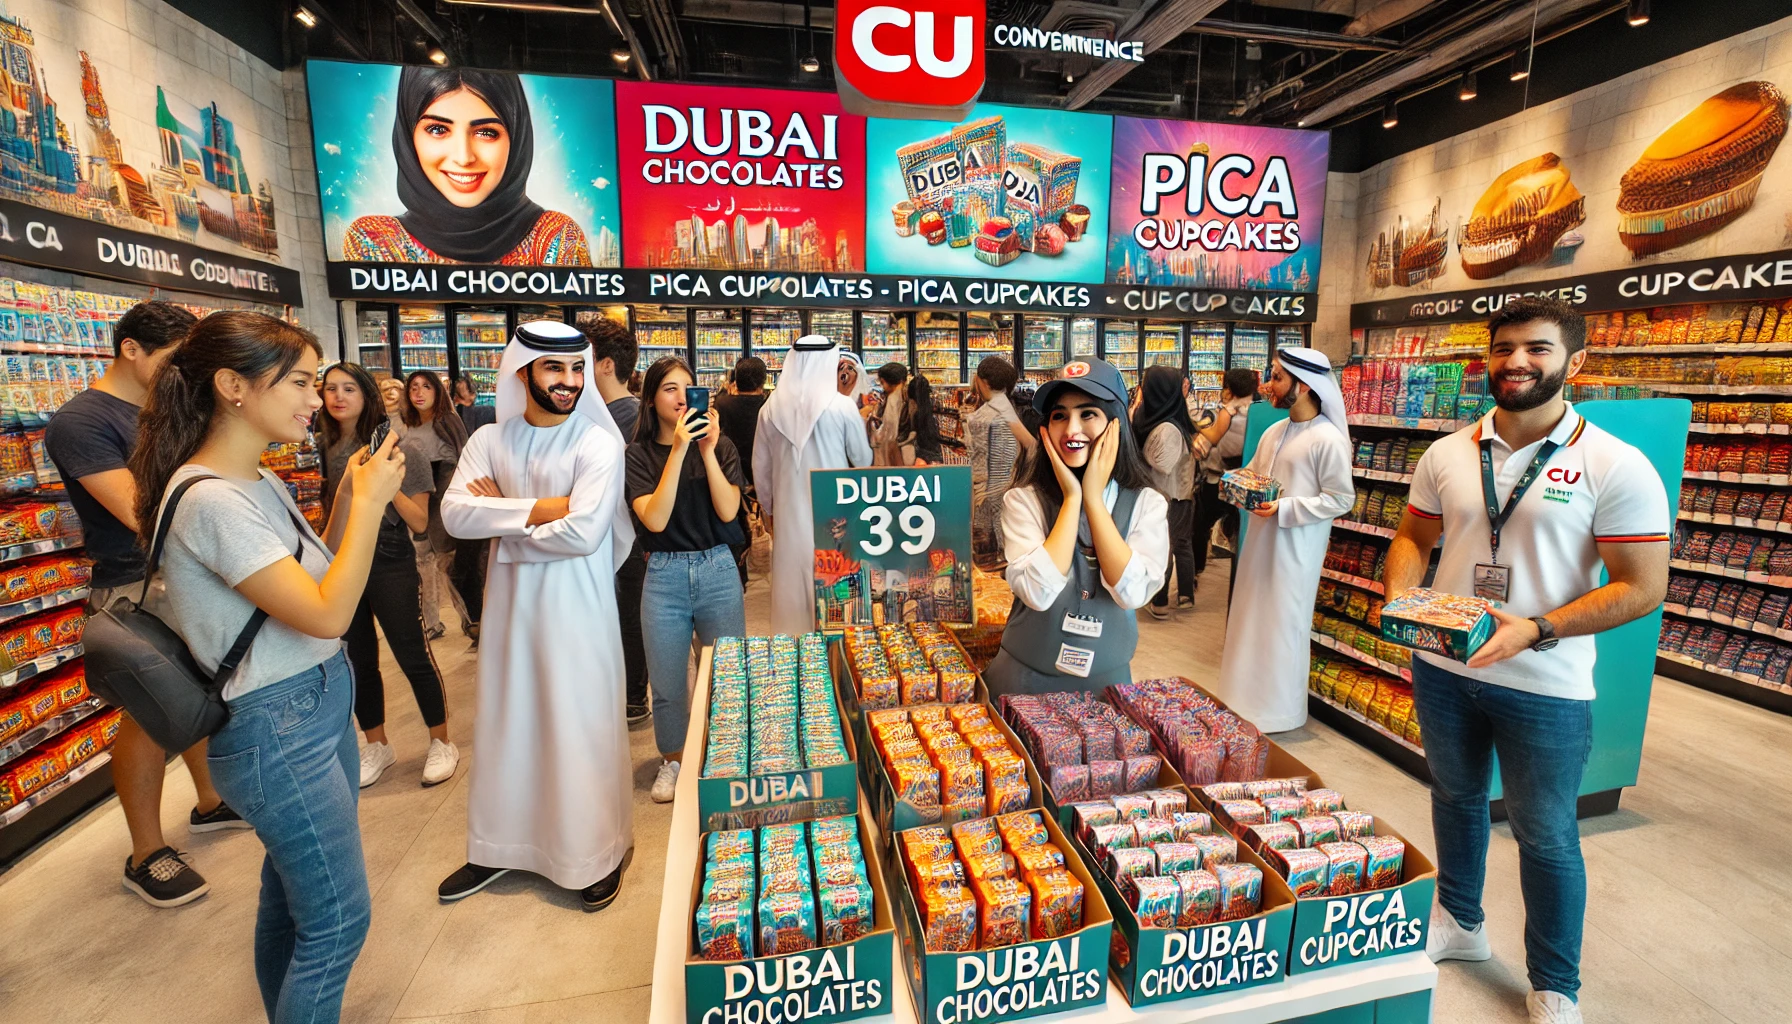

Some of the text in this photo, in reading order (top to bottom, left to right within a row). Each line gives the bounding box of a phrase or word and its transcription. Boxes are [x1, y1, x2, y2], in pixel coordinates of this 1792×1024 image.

[852, 6, 973, 78] CU
[642, 104, 838, 160] DUBAI
[642, 158, 843, 189] CHOCOLATES
[1141, 153, 1298, 219] PICA
[1134, 218, 1301, 252] CUPCAKES
[350, 268, 437, 291] DUBAI
[448, 270, 625, 296] CHOCOLATES
[650, 273, 711, 297] PICA
[898, 279, 958, 304] PICA
[965, 281, 1090, 307] CUPCAKES
[836, 475, 941, 504] DUBAI
[1547, 468, 1582, 484] CU
[859, 505, 936, 556] 39
[729, 771, 823, 807] DUBAI
[1323, 889, 1406, 932] PICA
[956, 936, 1080, 992] DUBAI
[1161, 918, 1267, 965] DUBAI
[1300, 917, 1422, 966] CUPCAKES
[724, 945, 855, 1001] DUBAI
[936, 968, 1101, 1024] CHOCOLATES
[1140, 950, 1279, 997] CHOCOLATES
[701, 979, 882, 1024] CHOCOLATES
